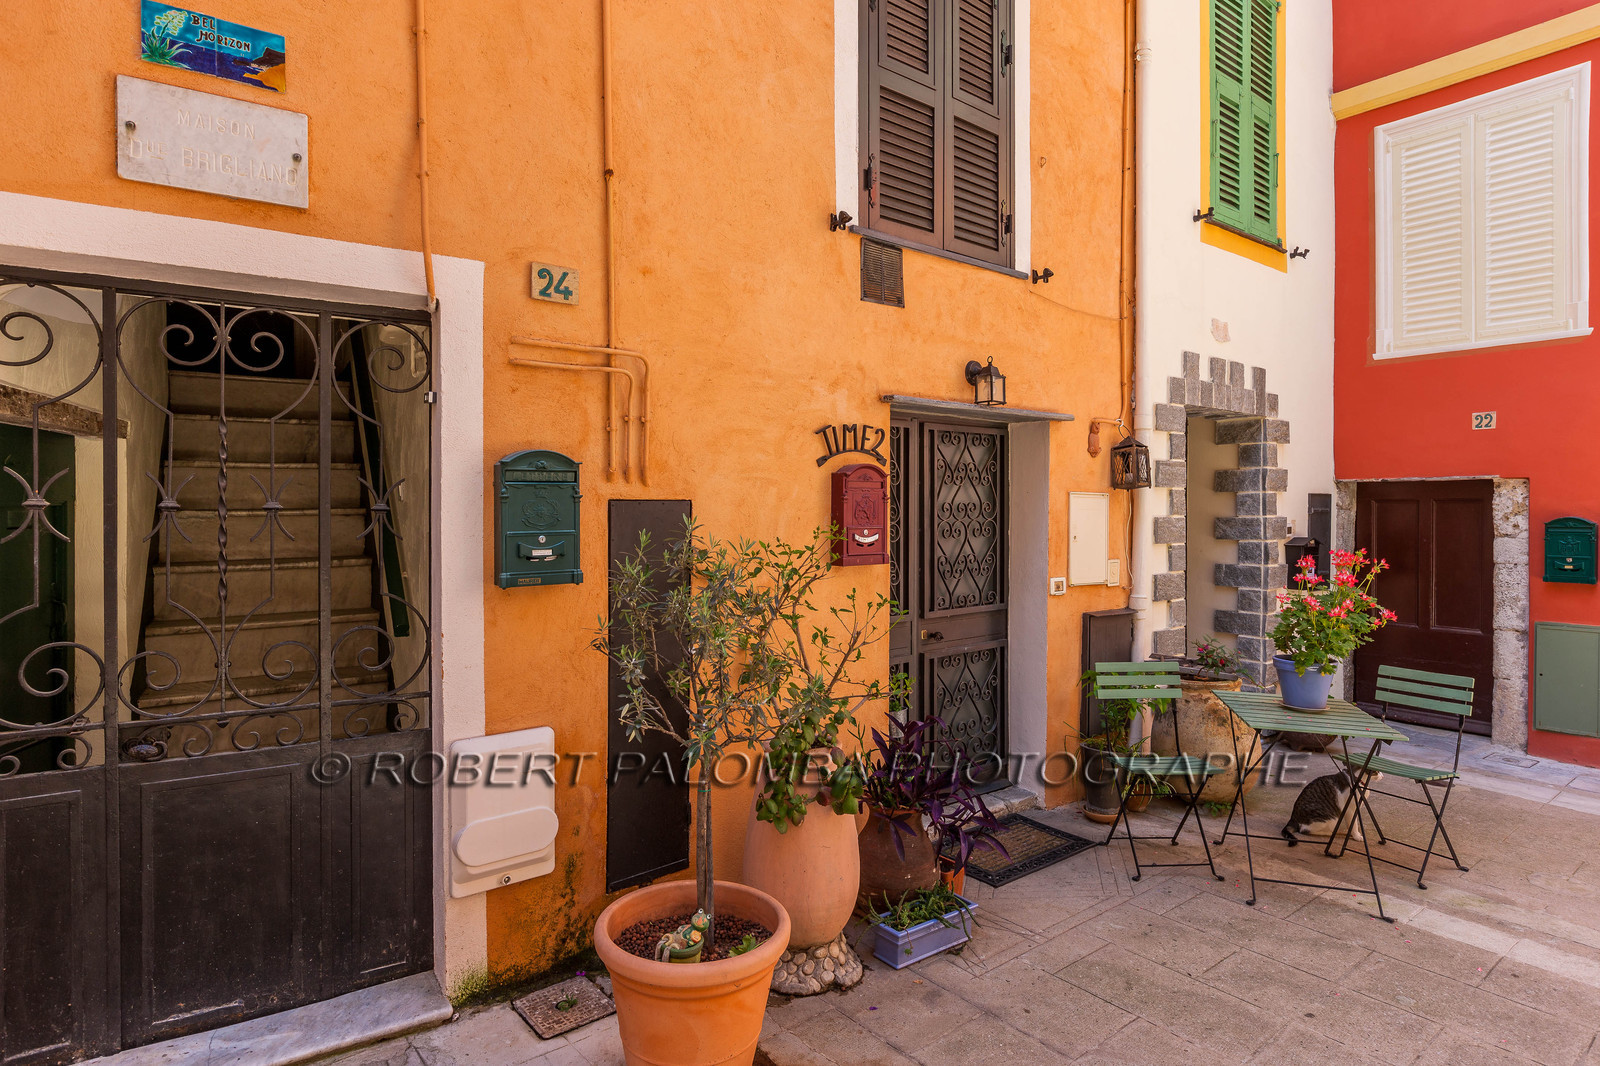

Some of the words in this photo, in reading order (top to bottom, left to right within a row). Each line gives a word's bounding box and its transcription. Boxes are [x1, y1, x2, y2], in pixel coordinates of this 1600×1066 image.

[191, 14, 216, 31] BEL
[196, 30, 251, 52] HORIZON
[177, 109, 256, 140] MAISON
[182, 147, 298, 186] BRIGLIANO
[537, 267, 573, 300] 24
[1474, 413, 1493, 428] 22
